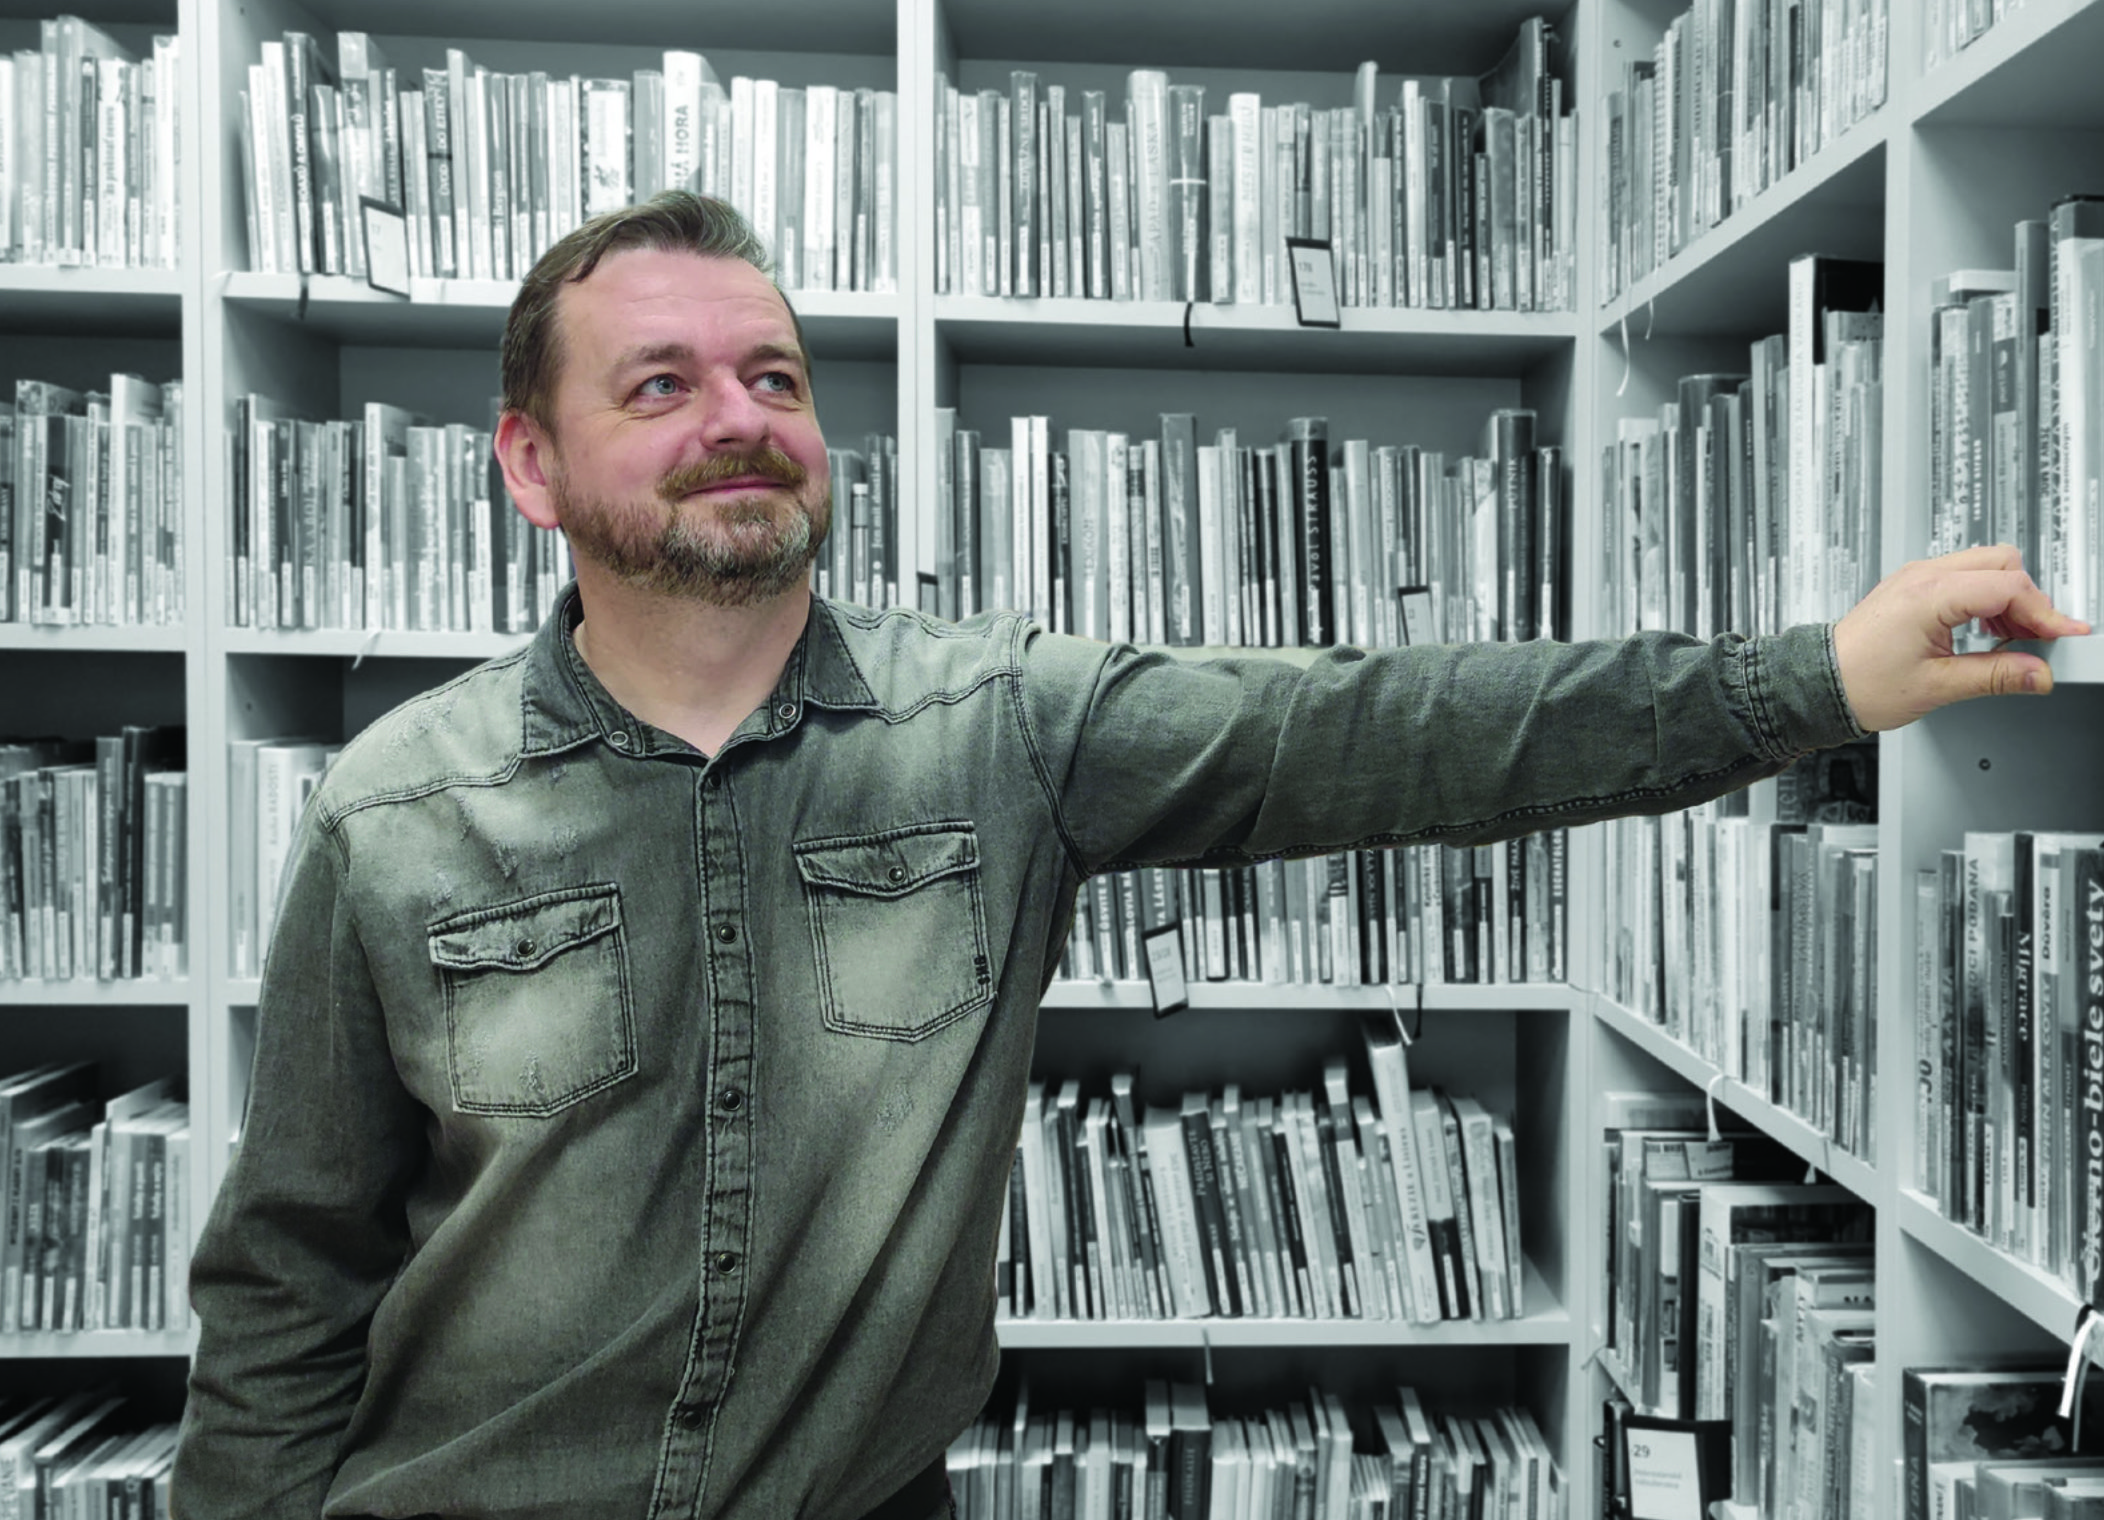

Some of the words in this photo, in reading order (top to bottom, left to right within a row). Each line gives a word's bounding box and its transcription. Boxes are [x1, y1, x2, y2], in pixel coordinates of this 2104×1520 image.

[674, 104, 690, 154] HORA
[1304, 454, 1319, 533] STRAUSS
[1510, 839, 1520, 866] PARA
[1552, 829, 1563, 897] ESCHATOLOG
[2083, 877, 2104, 996] svety
[2015, 929, 2032, 1041] Migrace
[2041, 981, 2051, 1045] COVEY
[1633, 1444, 1651, 1459] 29
